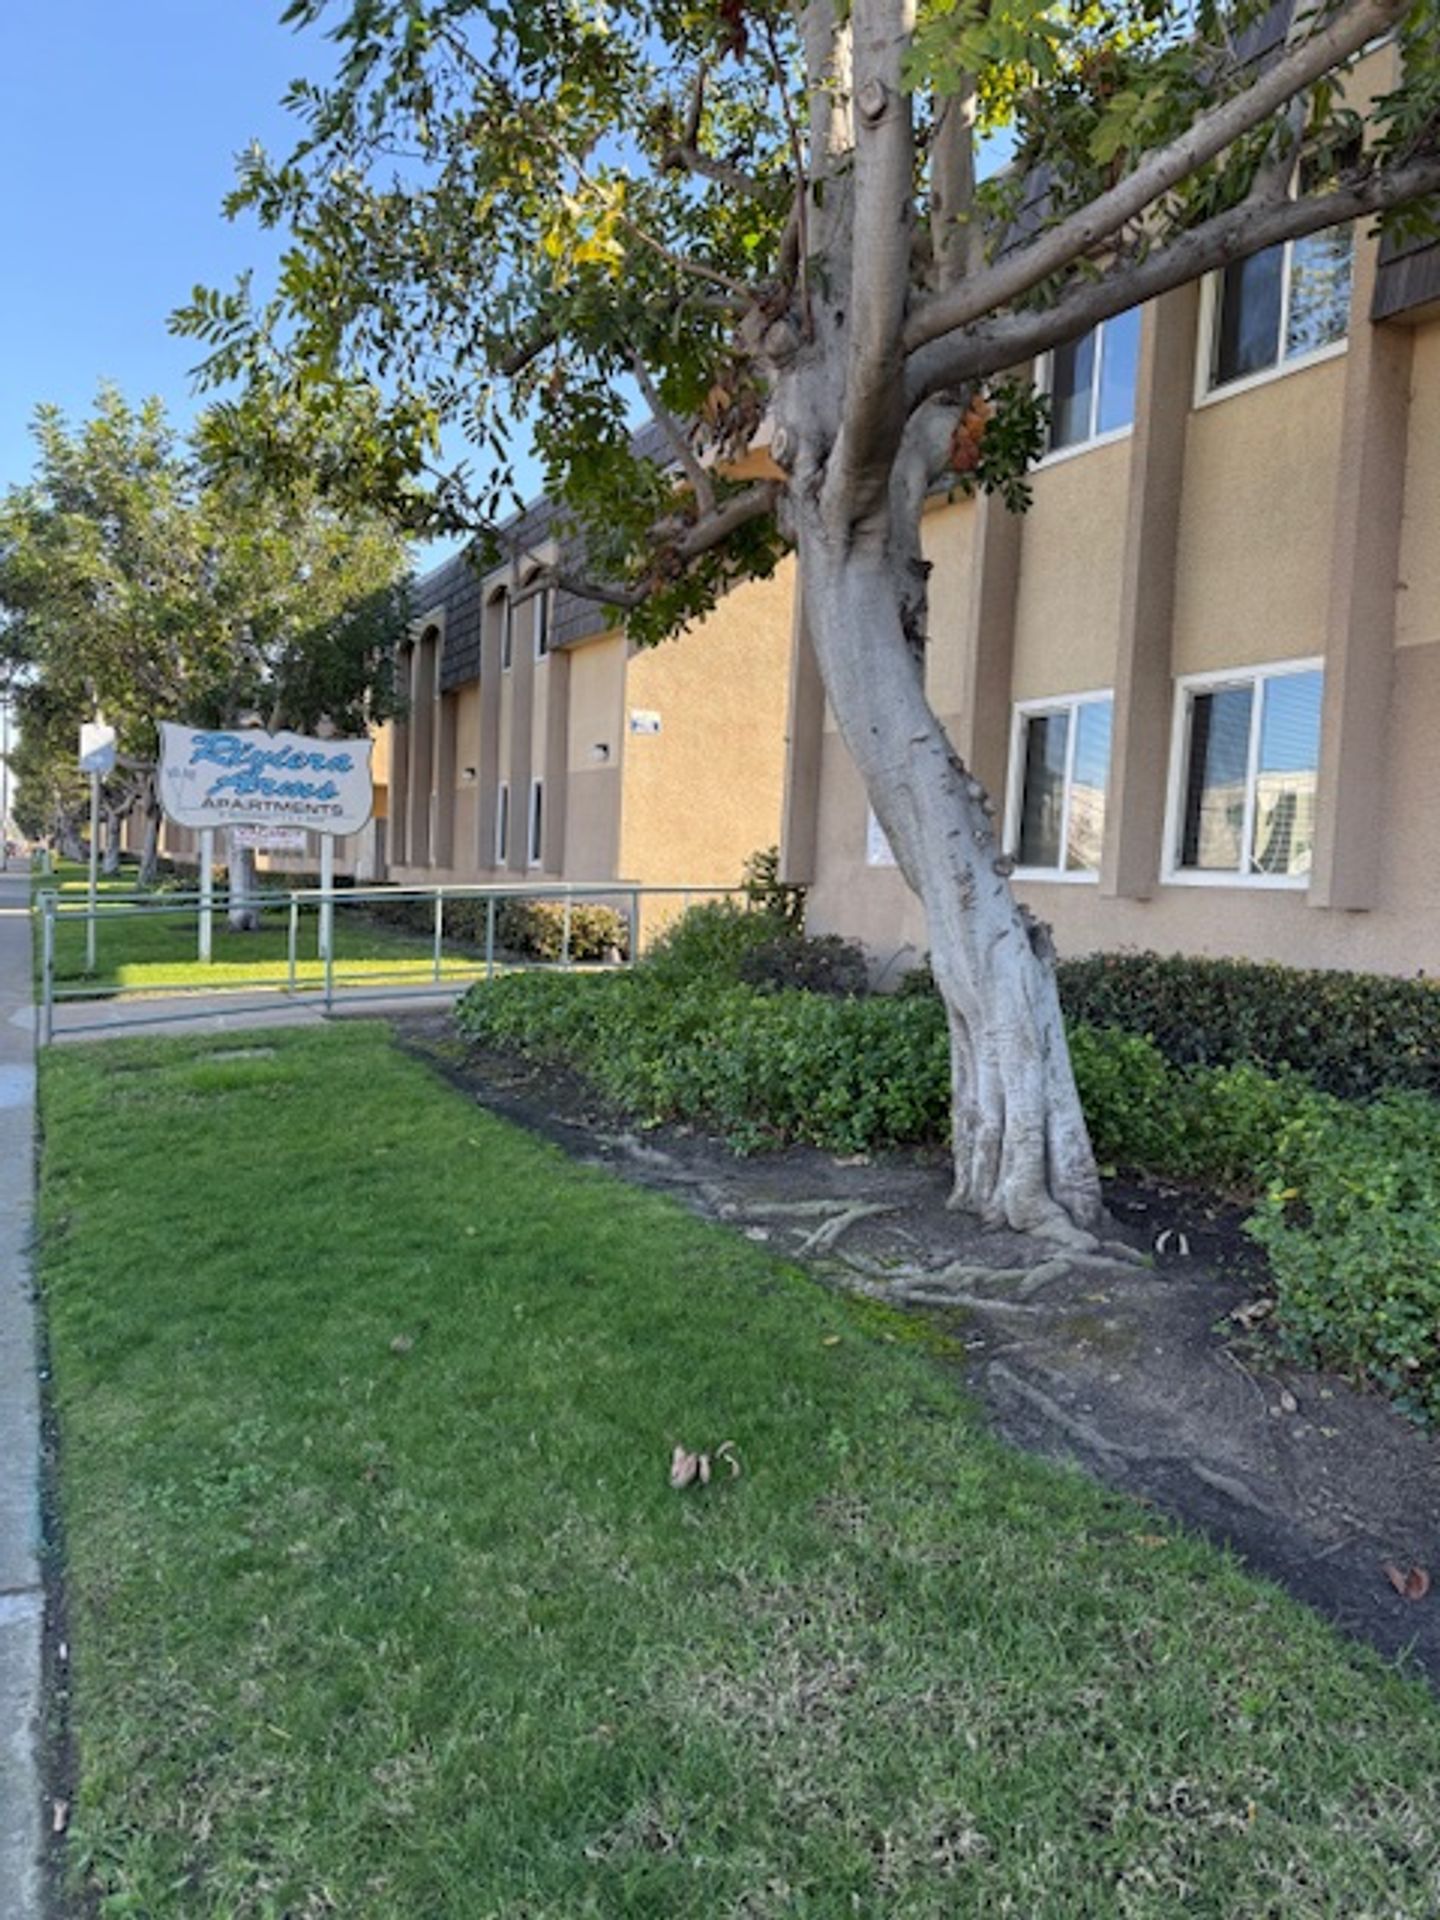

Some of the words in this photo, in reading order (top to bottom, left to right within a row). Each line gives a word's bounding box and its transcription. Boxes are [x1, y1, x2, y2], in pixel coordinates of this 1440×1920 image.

[190, 733, 354, 773] Riviera
[207, 770, 340, 801] Arms
[201, 797, 344, 816] APARTMENTS
